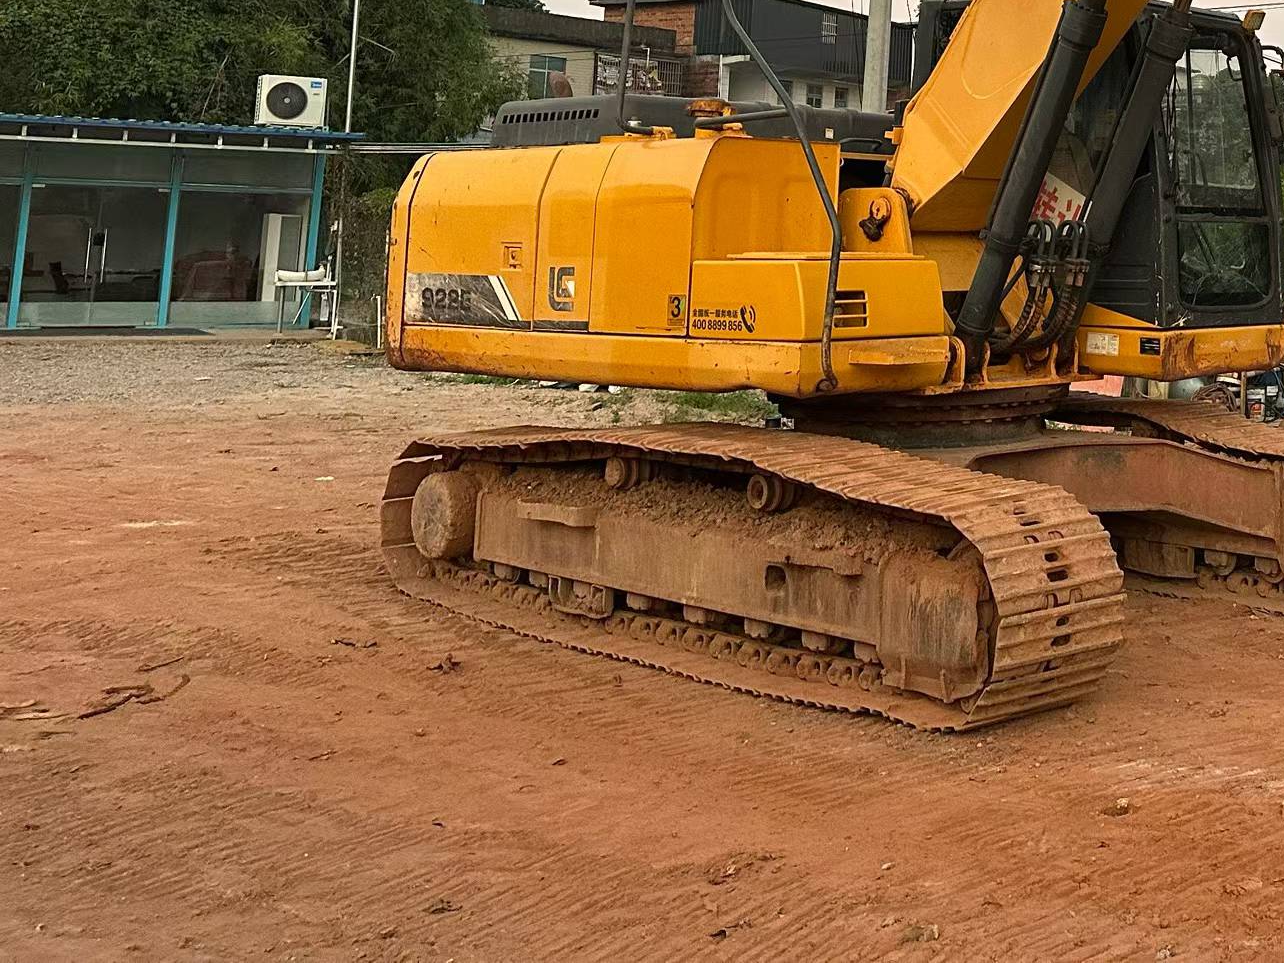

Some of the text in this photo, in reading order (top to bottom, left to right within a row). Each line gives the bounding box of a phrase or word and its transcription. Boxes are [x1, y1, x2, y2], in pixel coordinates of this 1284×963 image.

[671, 296, 681, 318] 3
[691, 319, 707, 330] 400
[707, 319, 727, 331] 8899
[727, 320, 743, 332] 856
